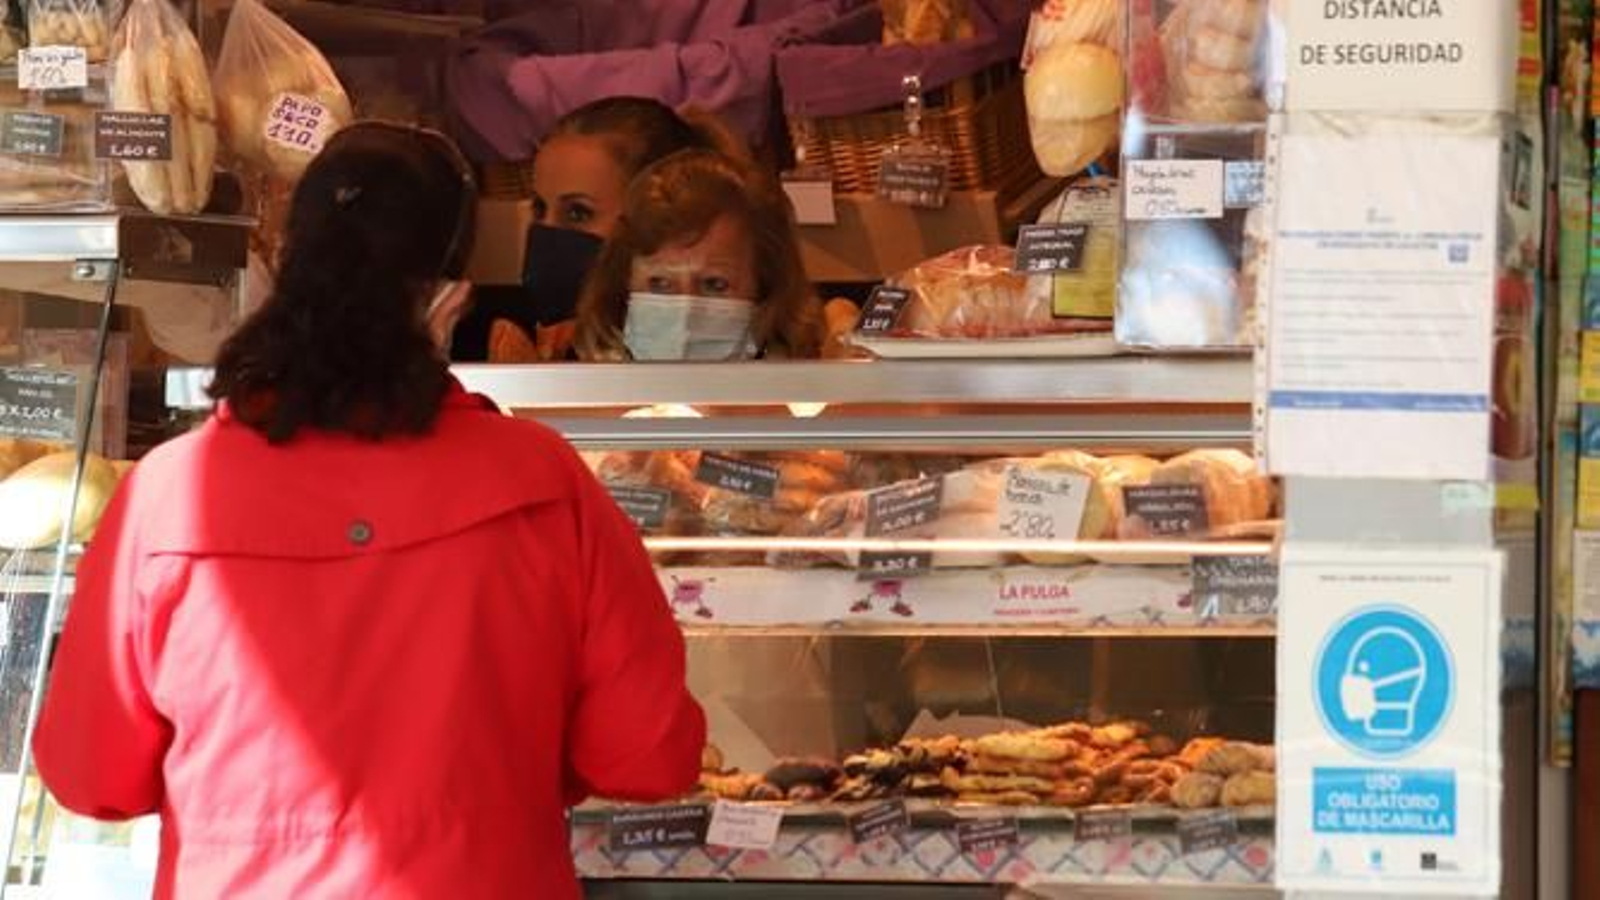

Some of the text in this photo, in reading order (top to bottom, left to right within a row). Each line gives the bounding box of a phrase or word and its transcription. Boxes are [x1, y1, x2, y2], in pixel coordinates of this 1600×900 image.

[1323, 0, 1442, 19] DISTANCIA
[1299, 43, 1463, 65] DE SEGURIDAD
[999, 584, 1069, 599] LA PULGA
[1365, 774, 1401, 790] USO
[1327, 791, 1440, 810] OBLIGATORIO
[1317, 810, 1450, 830] DE MASCARILLA
